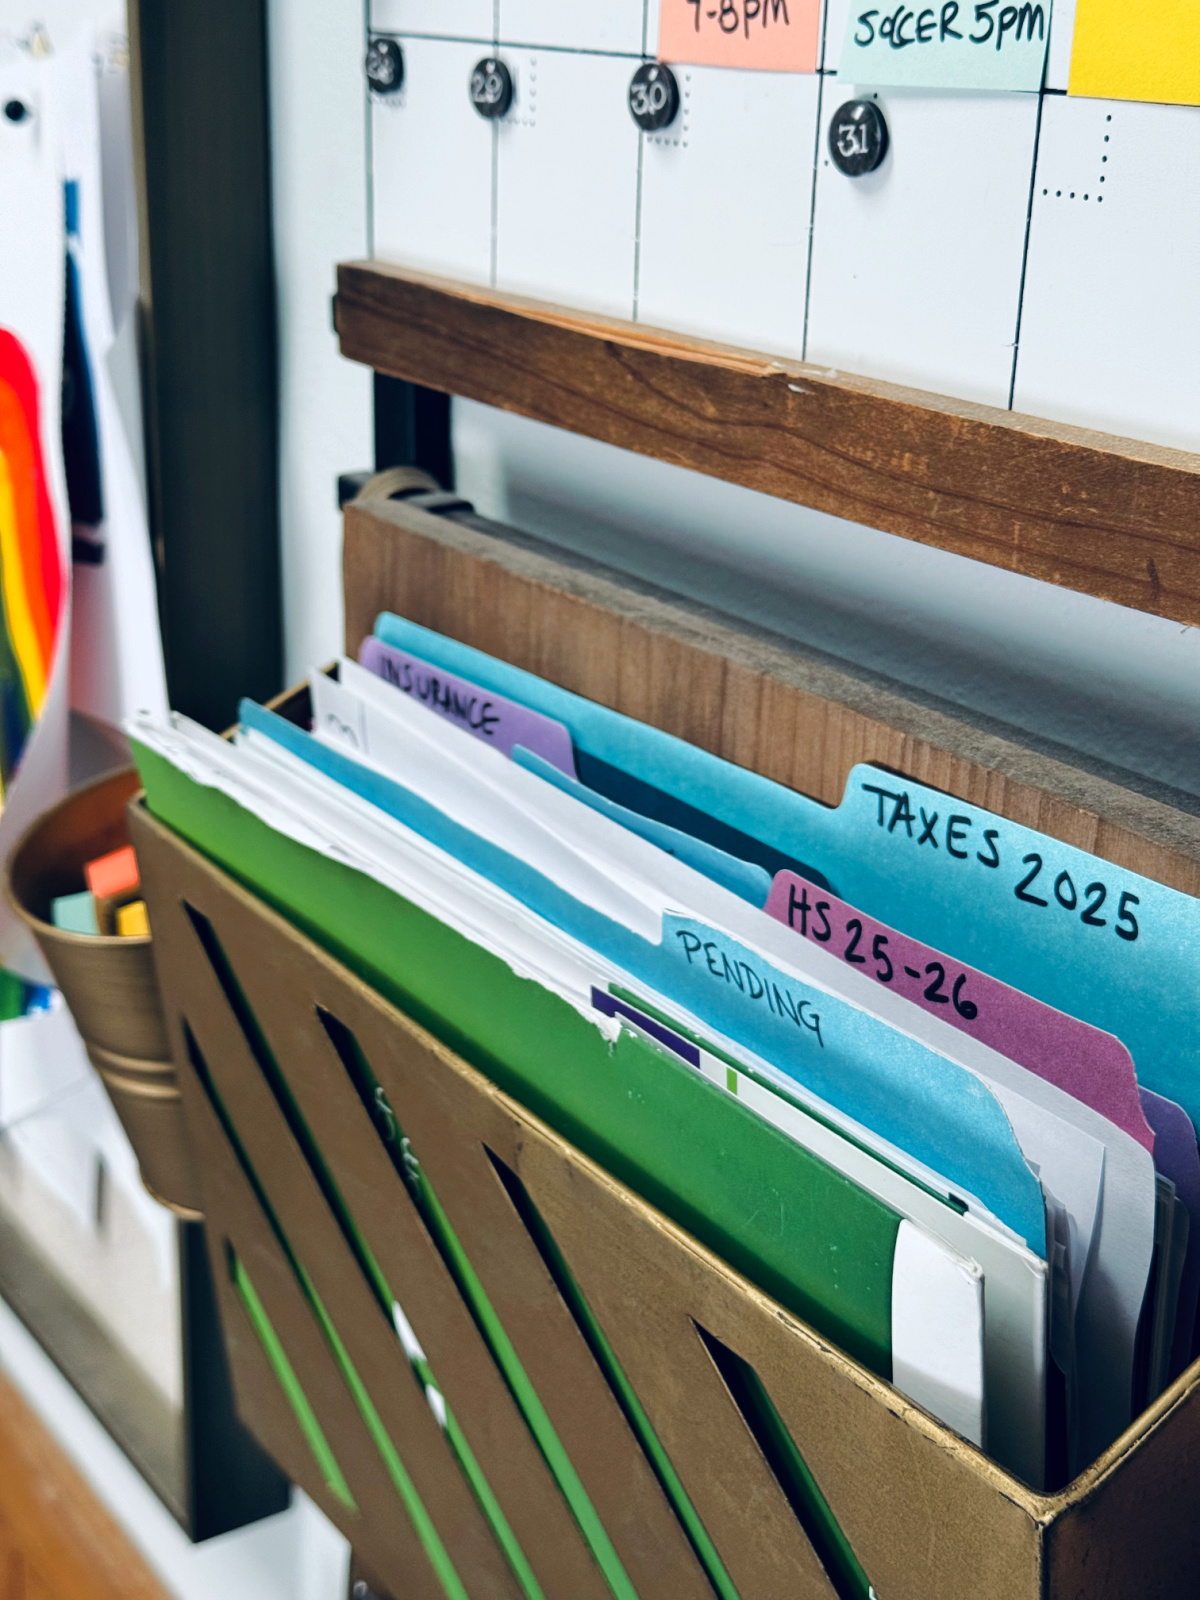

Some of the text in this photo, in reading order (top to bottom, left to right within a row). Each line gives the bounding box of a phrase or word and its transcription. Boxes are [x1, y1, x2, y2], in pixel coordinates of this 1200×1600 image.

[472, 71, 503, 103] 29
[631, 81, 666, 115] 30
[836, 123, 869, 157] 31
[381, 654, 501, 736] INSURANCE
[861, 782, 1141, 942] TAXES 2025
[675, 929, 826, 1048] PENDING
[787, 883, 979, 1020] HS 25-26
